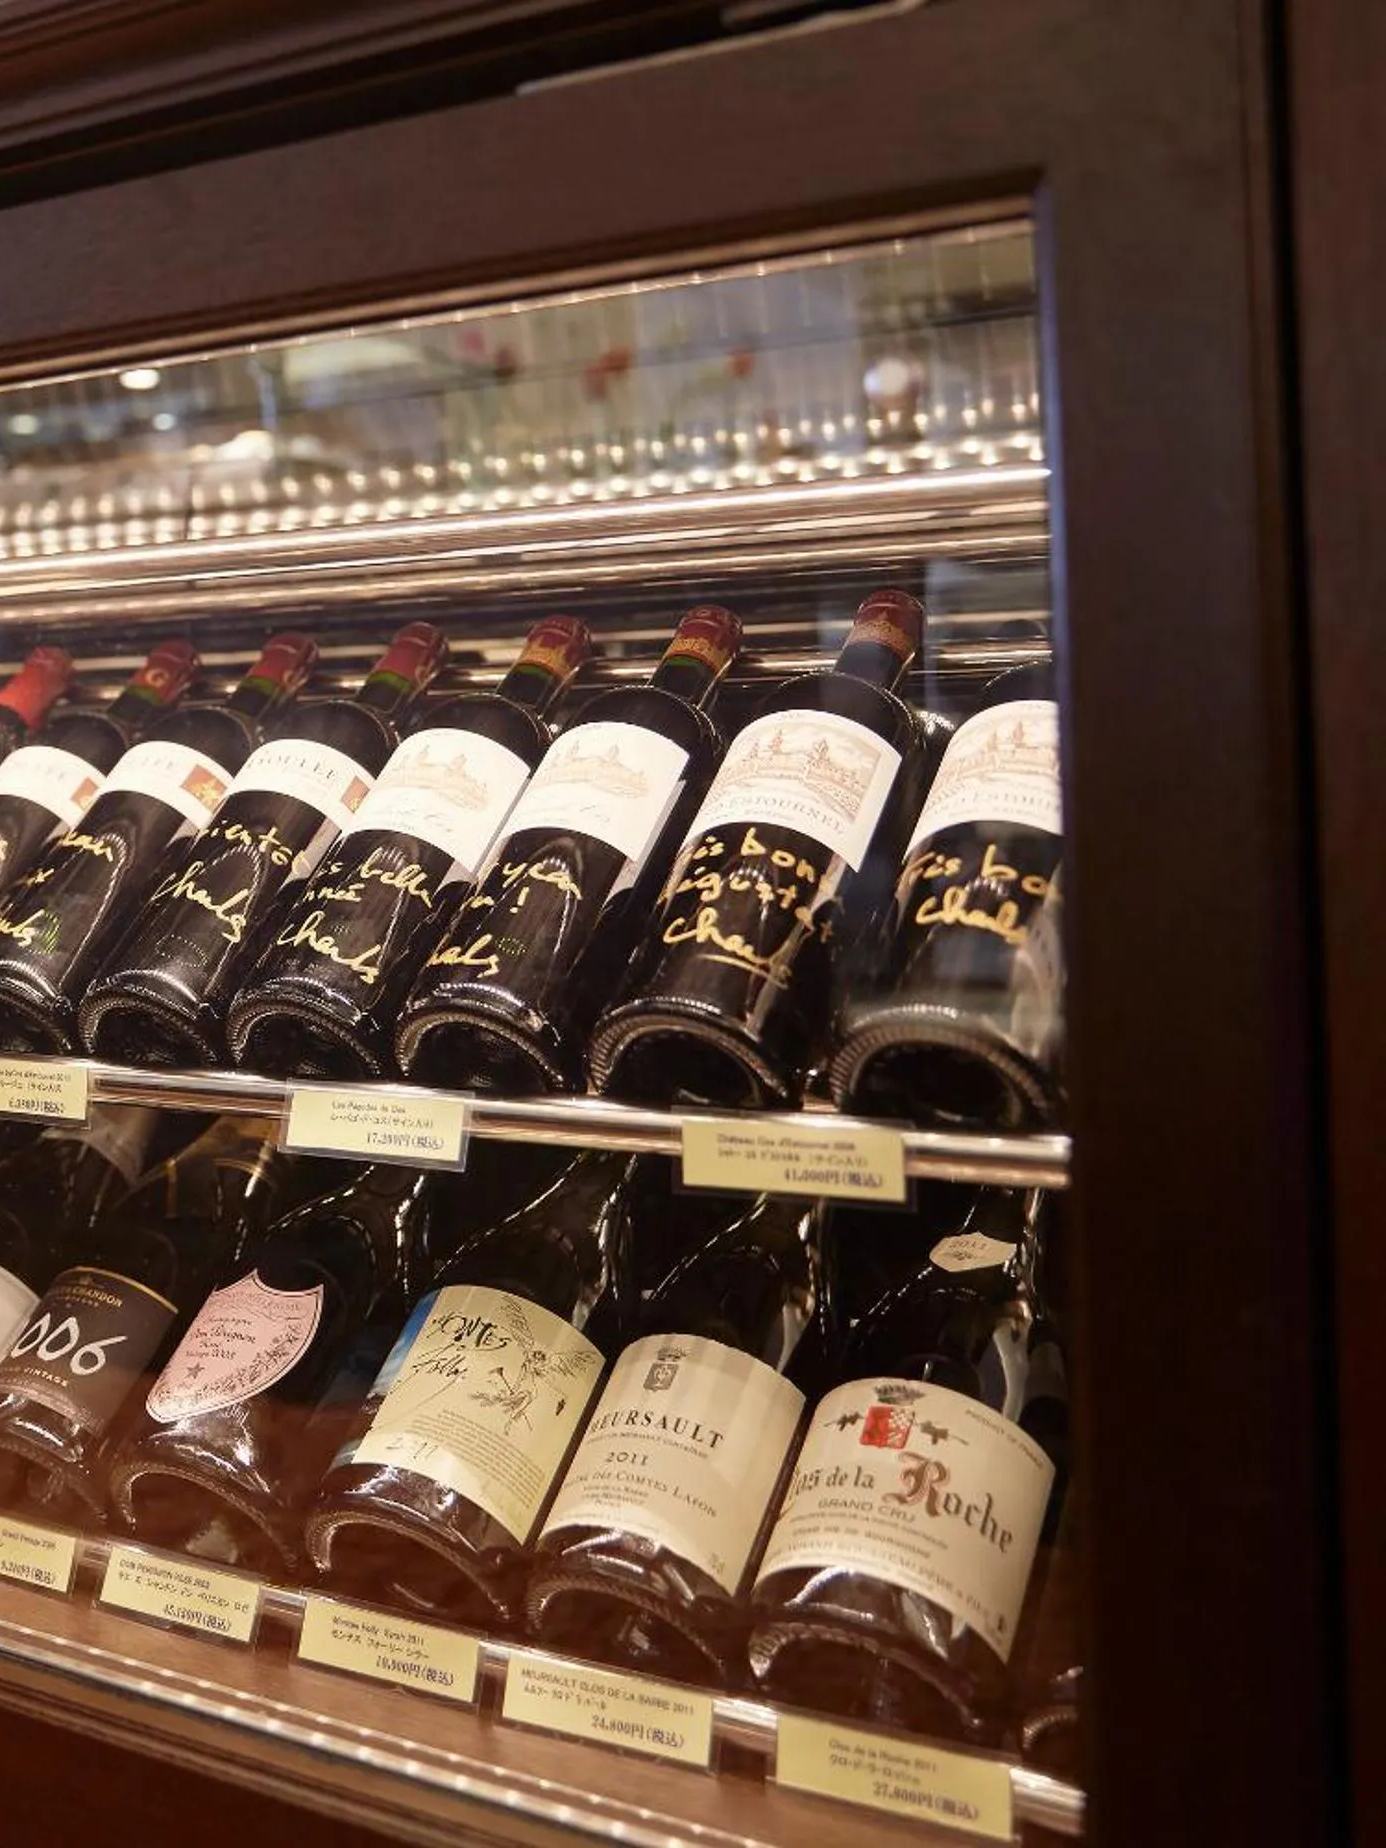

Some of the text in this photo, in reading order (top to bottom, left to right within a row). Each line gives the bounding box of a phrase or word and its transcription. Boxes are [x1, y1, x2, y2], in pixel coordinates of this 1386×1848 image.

[10, 1311, 128, 1377] 006
[606, 1451, 649, 1467] 2011
[826, 1466, 849, 1489] de
[854, 1466, 876, 1490] la
[881, 1451, 1014, 1553] Roche
